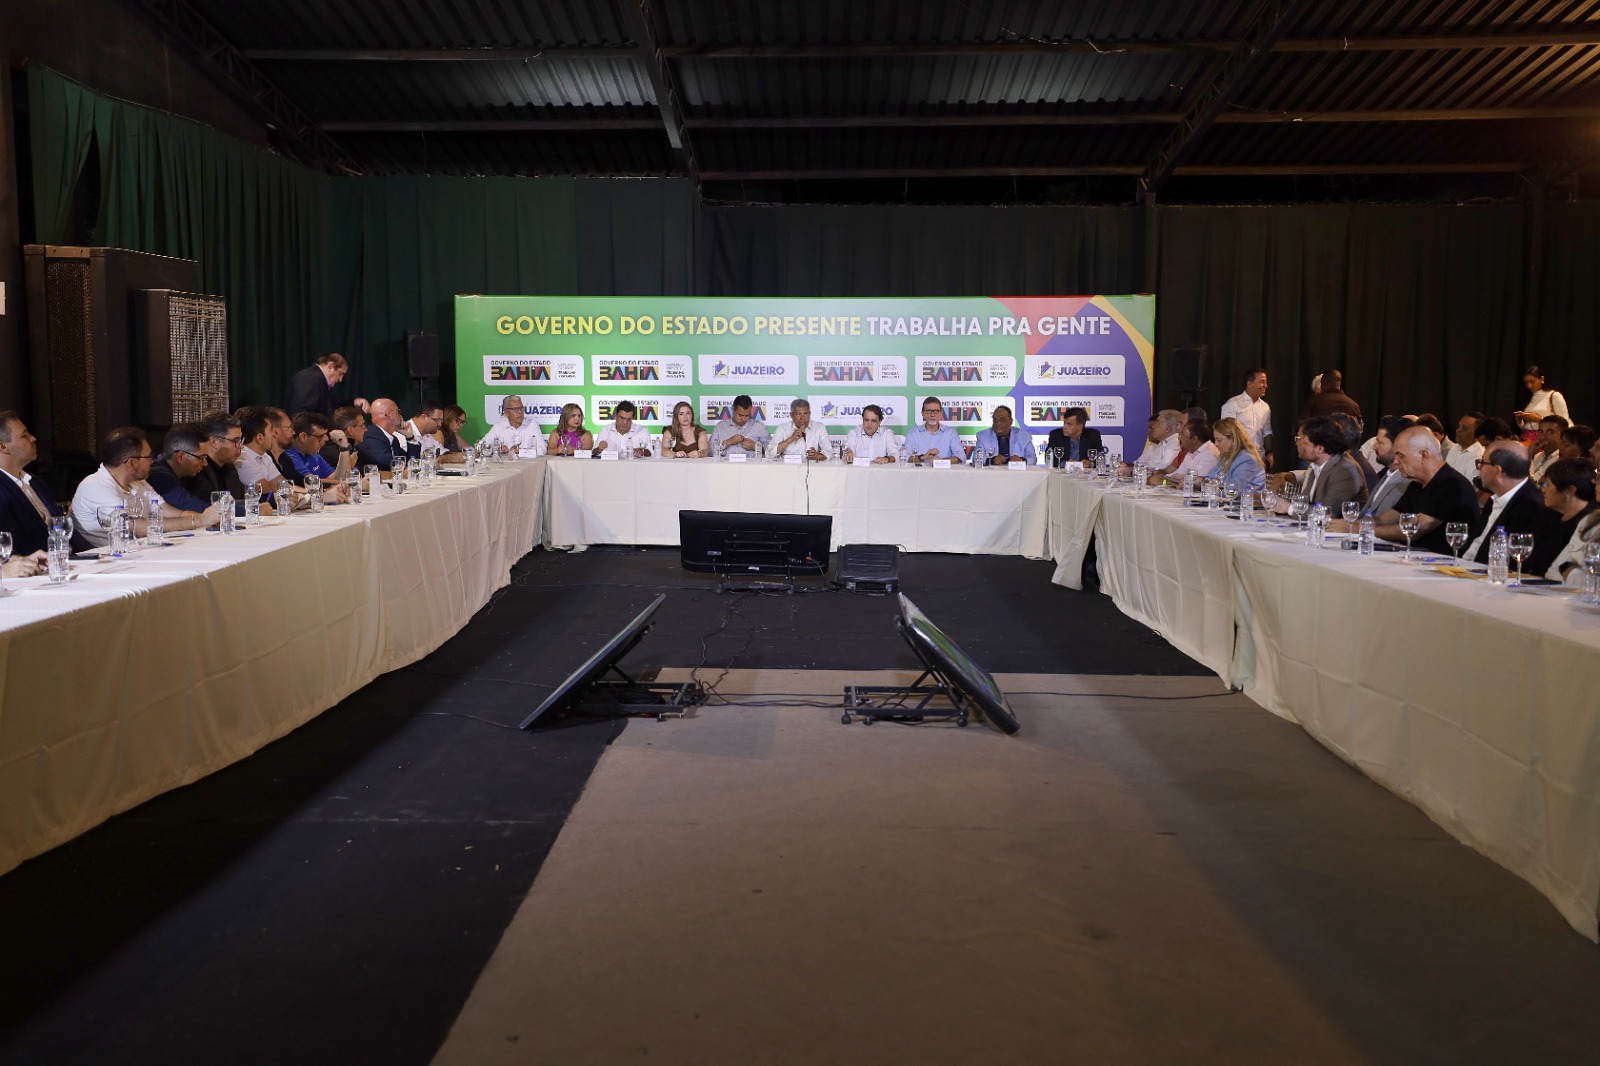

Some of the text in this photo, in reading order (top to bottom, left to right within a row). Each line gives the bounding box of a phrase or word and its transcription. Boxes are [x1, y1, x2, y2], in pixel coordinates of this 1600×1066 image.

[496, 315, 1111, 336] GOVERNO DO ESTADO PRESENTE TRABALHA PRA GENTE
[491, 366, 551, 380] BAHIA
[599, 366, 659, 380] BAHIA
[731, 366, 785, 375] JUAZEIRO
[814, 366, 874, 381] BAHIA
[923, 367, 983, 381] BAHIA
[1057, 366, 1111, 376] JUAZEIRO
[524, 406, 563, 415] UAZEIR
[707, 406, 767, 420] BAA
